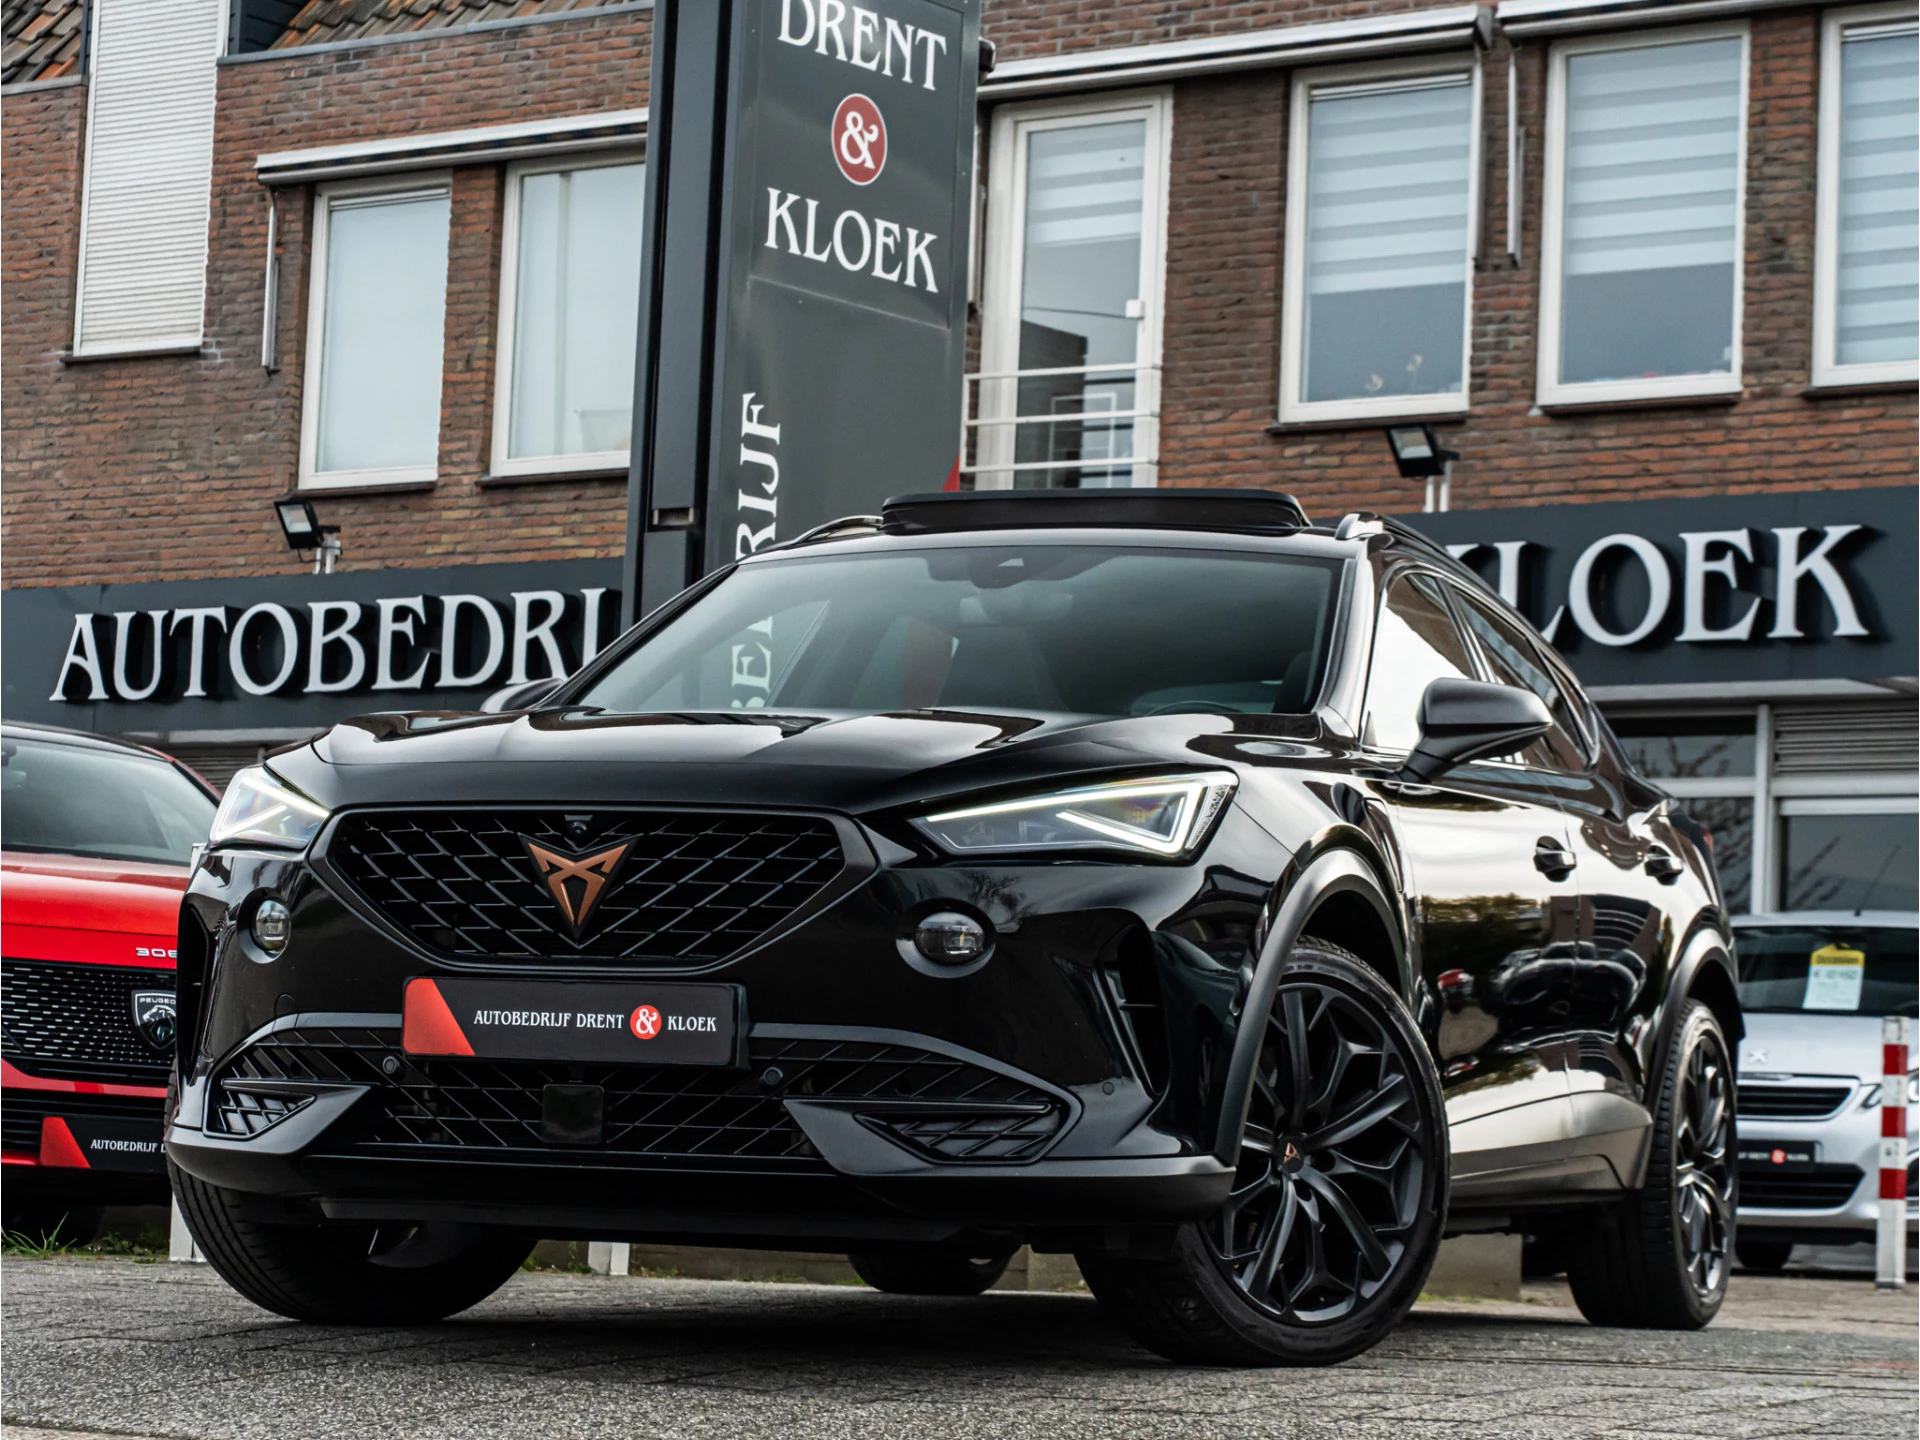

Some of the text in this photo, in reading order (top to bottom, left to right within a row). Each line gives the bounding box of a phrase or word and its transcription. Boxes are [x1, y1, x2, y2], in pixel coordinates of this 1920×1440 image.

[777, 0, 947, 91] DRENT
[839, 110, 879, 170] &
[764, 187, 939, 293] KLOEK
[49, 524, 1870, 701] AUTOBEDRI LOEK
[473, 1008, 717, 1034] AUTOBEDRIJF DRENT & KLOEK
[90, 1138, 158, 1153] AUTOBEDRIJF
